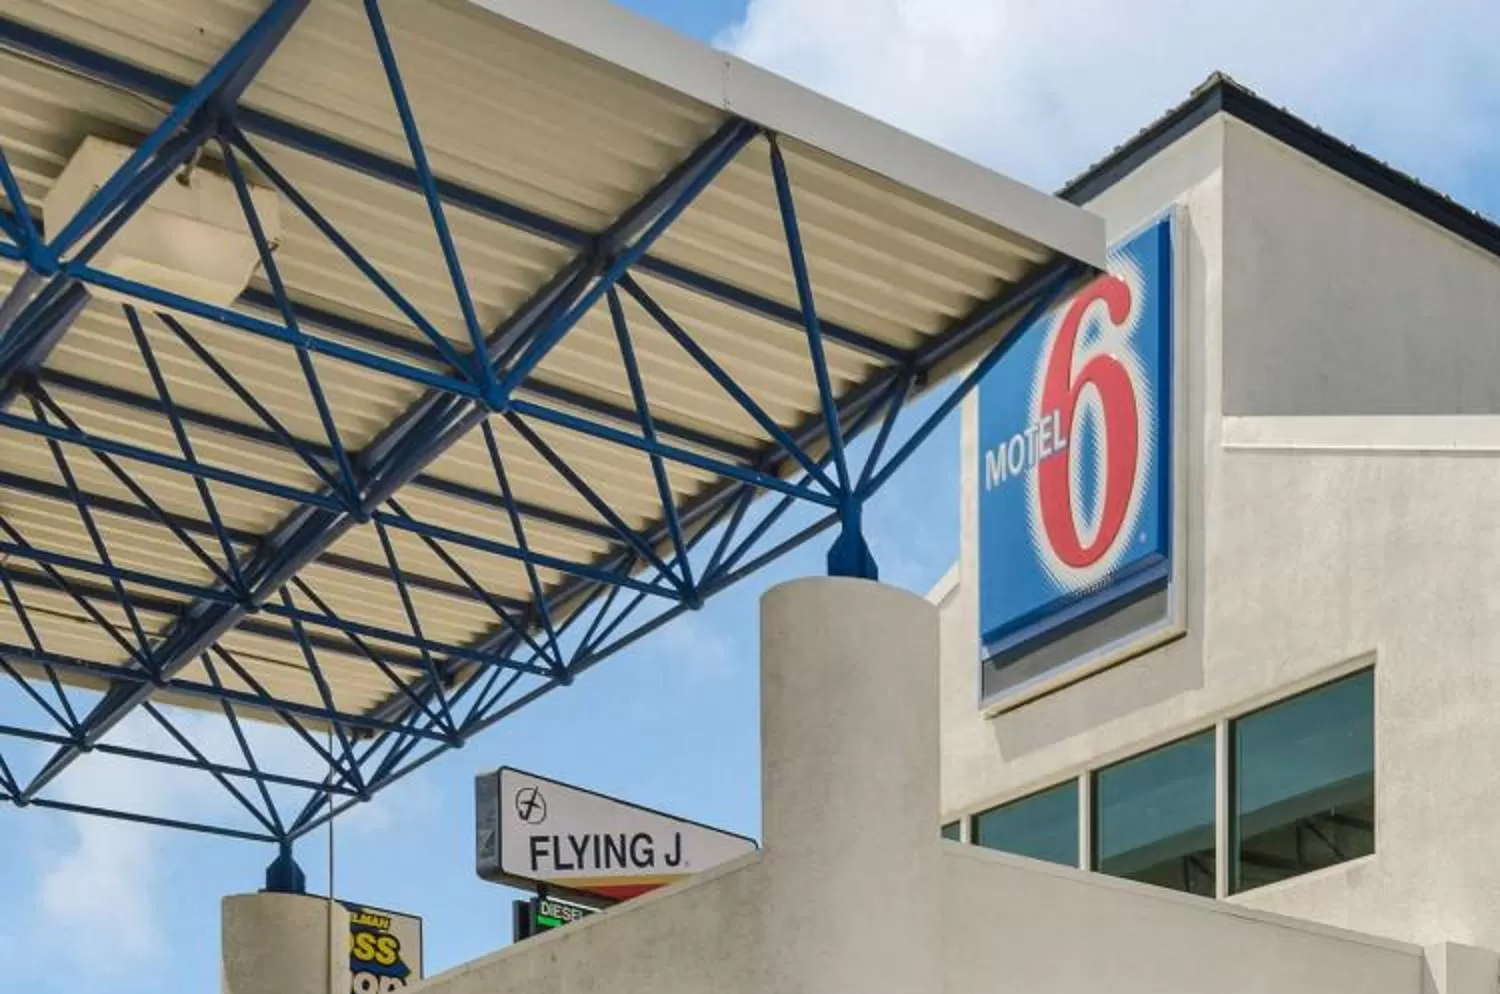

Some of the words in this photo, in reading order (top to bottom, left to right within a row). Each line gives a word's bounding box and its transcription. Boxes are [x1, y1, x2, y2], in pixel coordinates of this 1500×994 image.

[984, 409, 1068, 492] MOTEL
[1038, 275, 1139, 568] 6
[529, 832, 655, 871] FLYING
[665, 832, 683, 868] J
